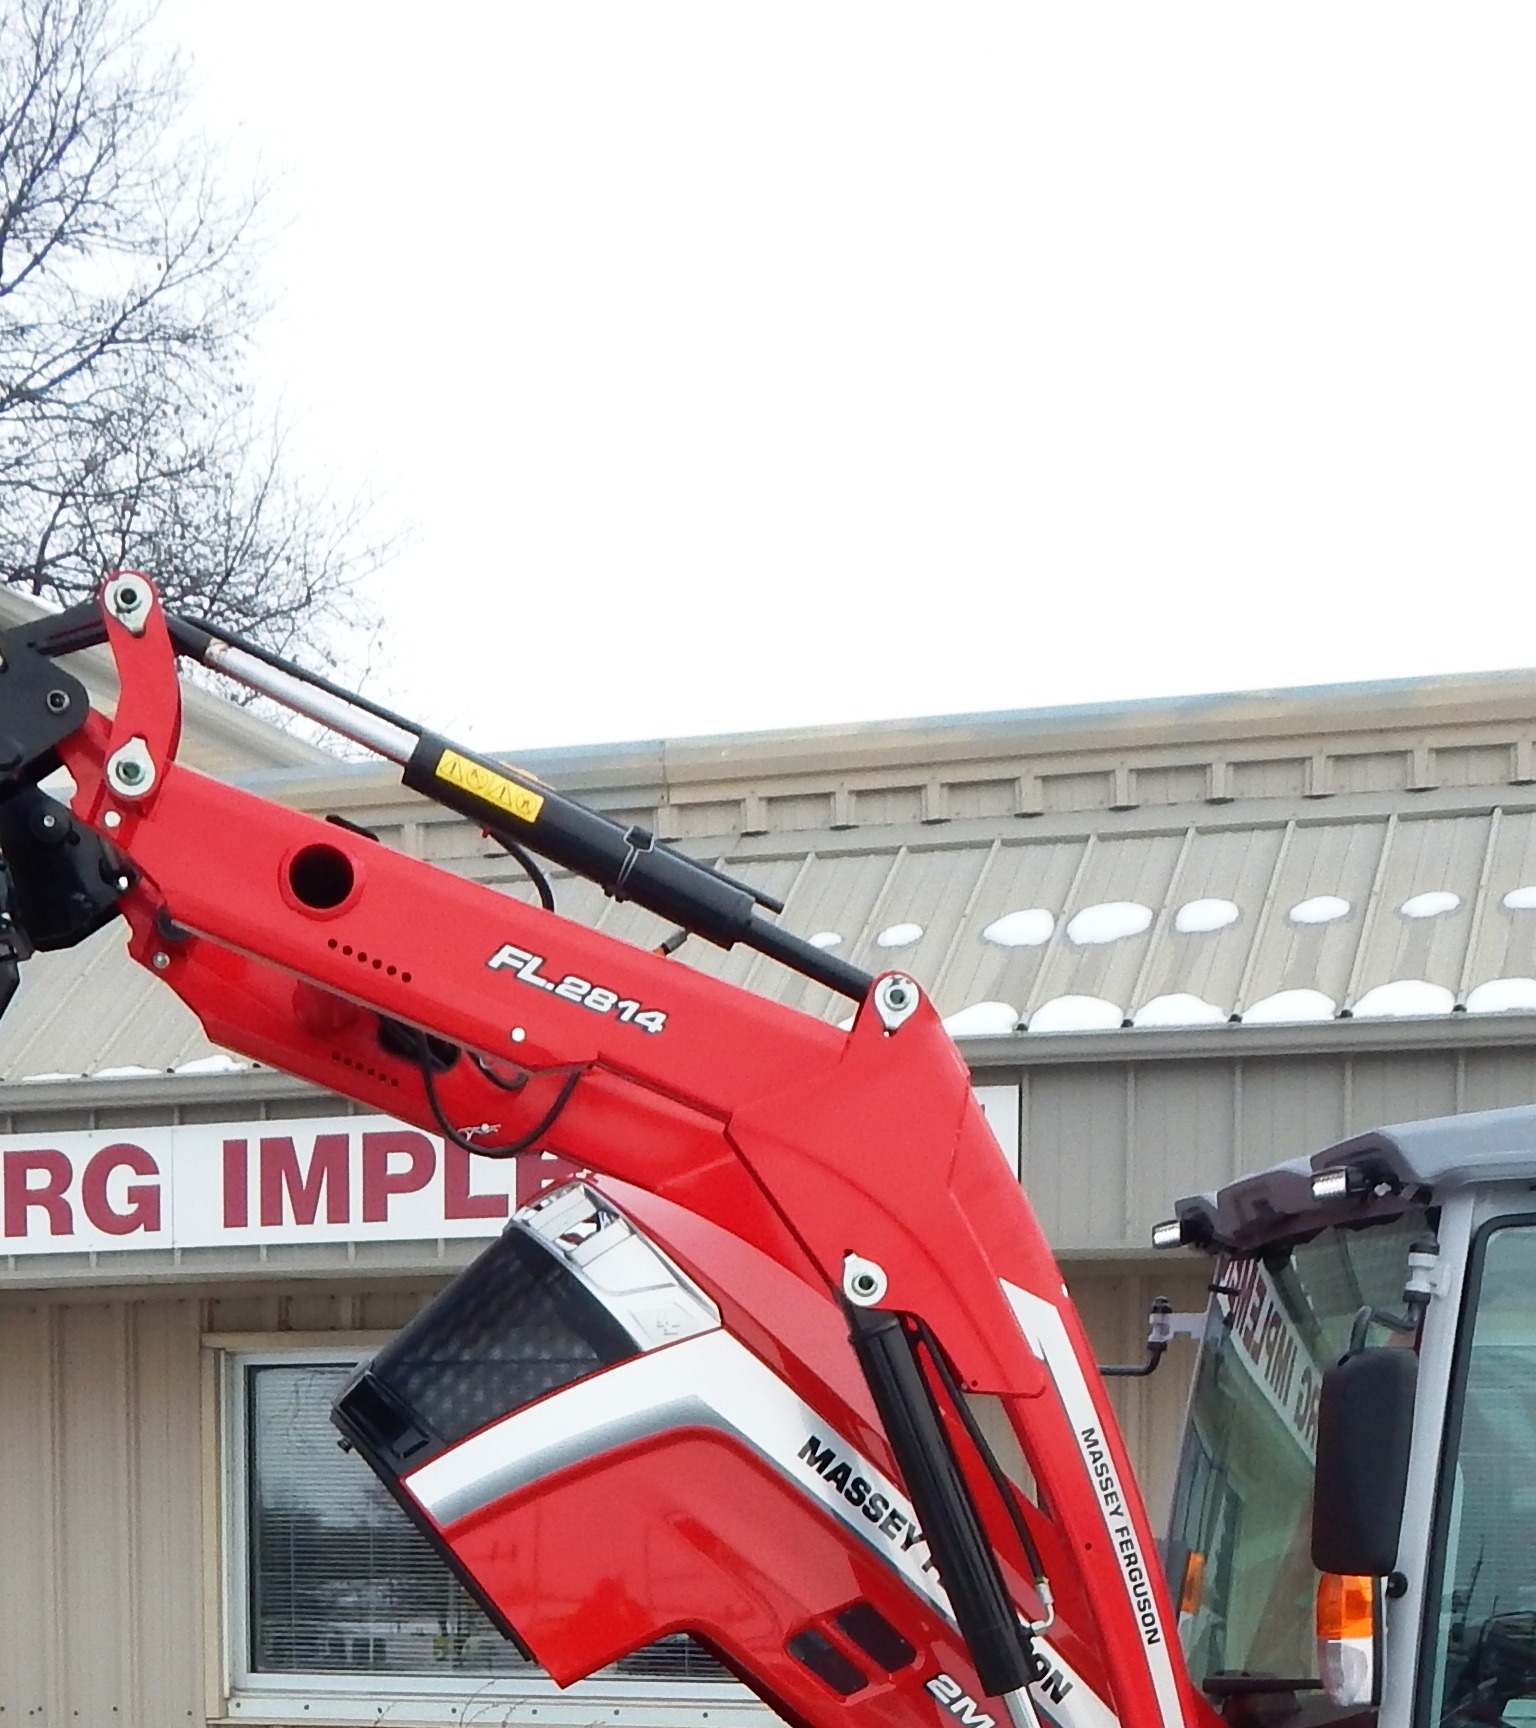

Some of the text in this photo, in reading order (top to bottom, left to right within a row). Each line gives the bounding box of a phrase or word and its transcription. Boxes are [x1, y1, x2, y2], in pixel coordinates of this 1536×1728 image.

[487, 943, 668, 1034] FL.2814
[797, 1435, 926, 1552] MASSEY
[1081, 1427, 1161, 1645] MASSEY FERGUSON
